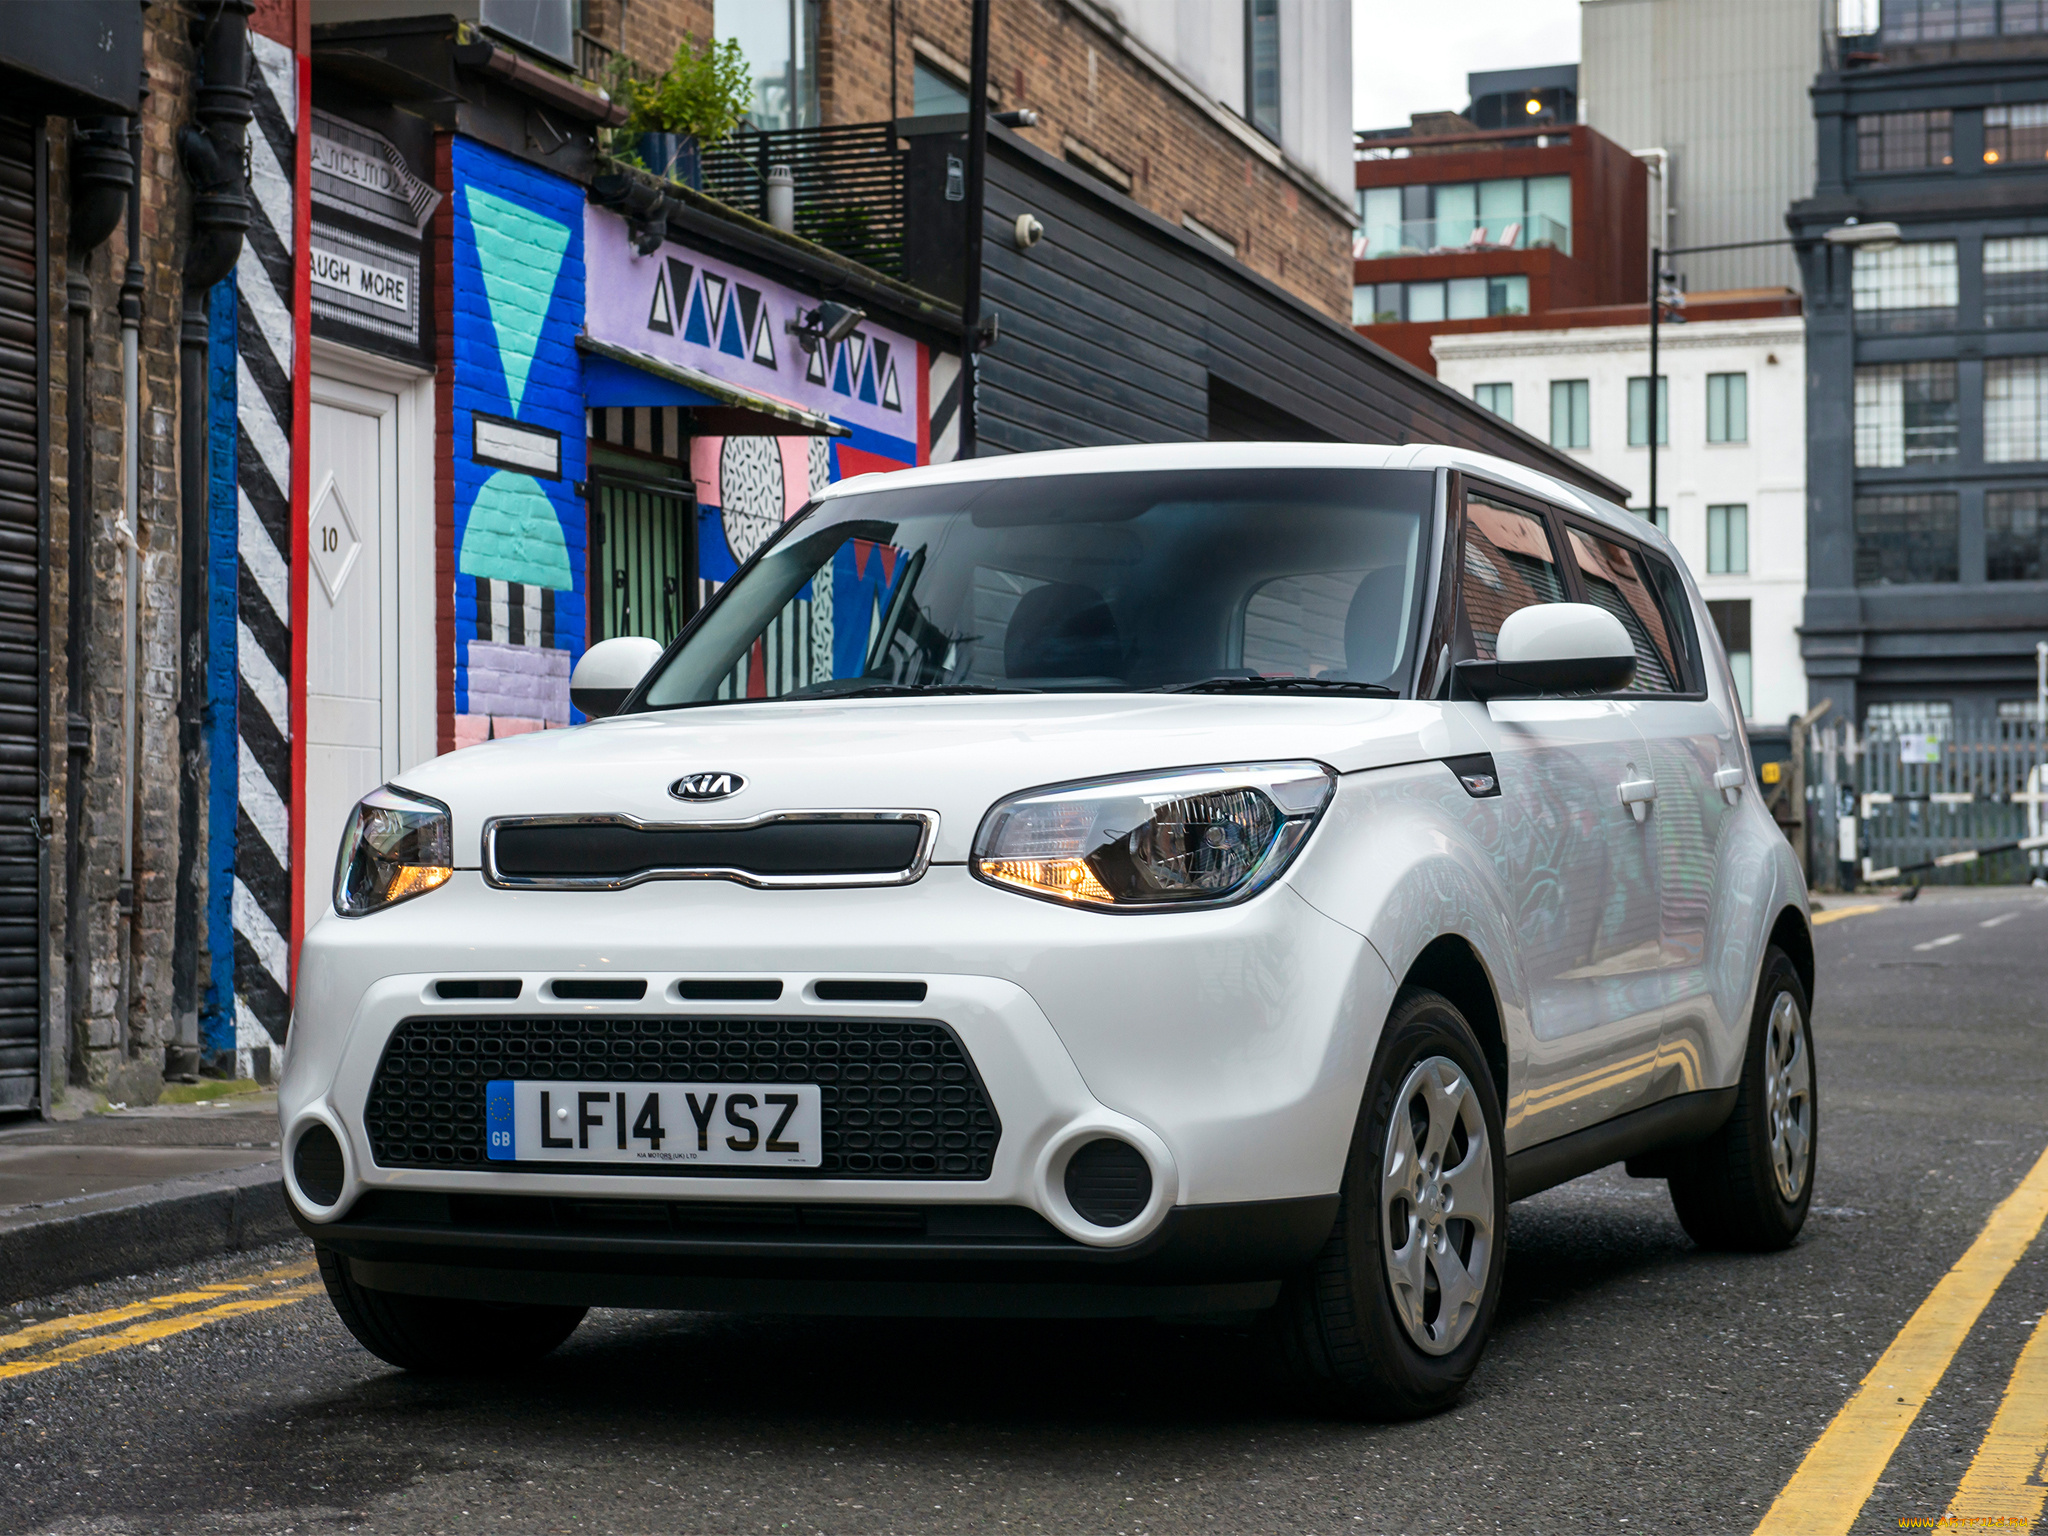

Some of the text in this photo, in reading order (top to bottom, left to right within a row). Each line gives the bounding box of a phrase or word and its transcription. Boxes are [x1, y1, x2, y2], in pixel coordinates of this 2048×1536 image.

[360, 267, 404, 304] MORE
[322, 525, 338, 552] 10
[677, 774, 731, 795] KIA
[540, 1090, 800, 1153] LF14 YSZ
[492, 1131, 510, 1147] GB
